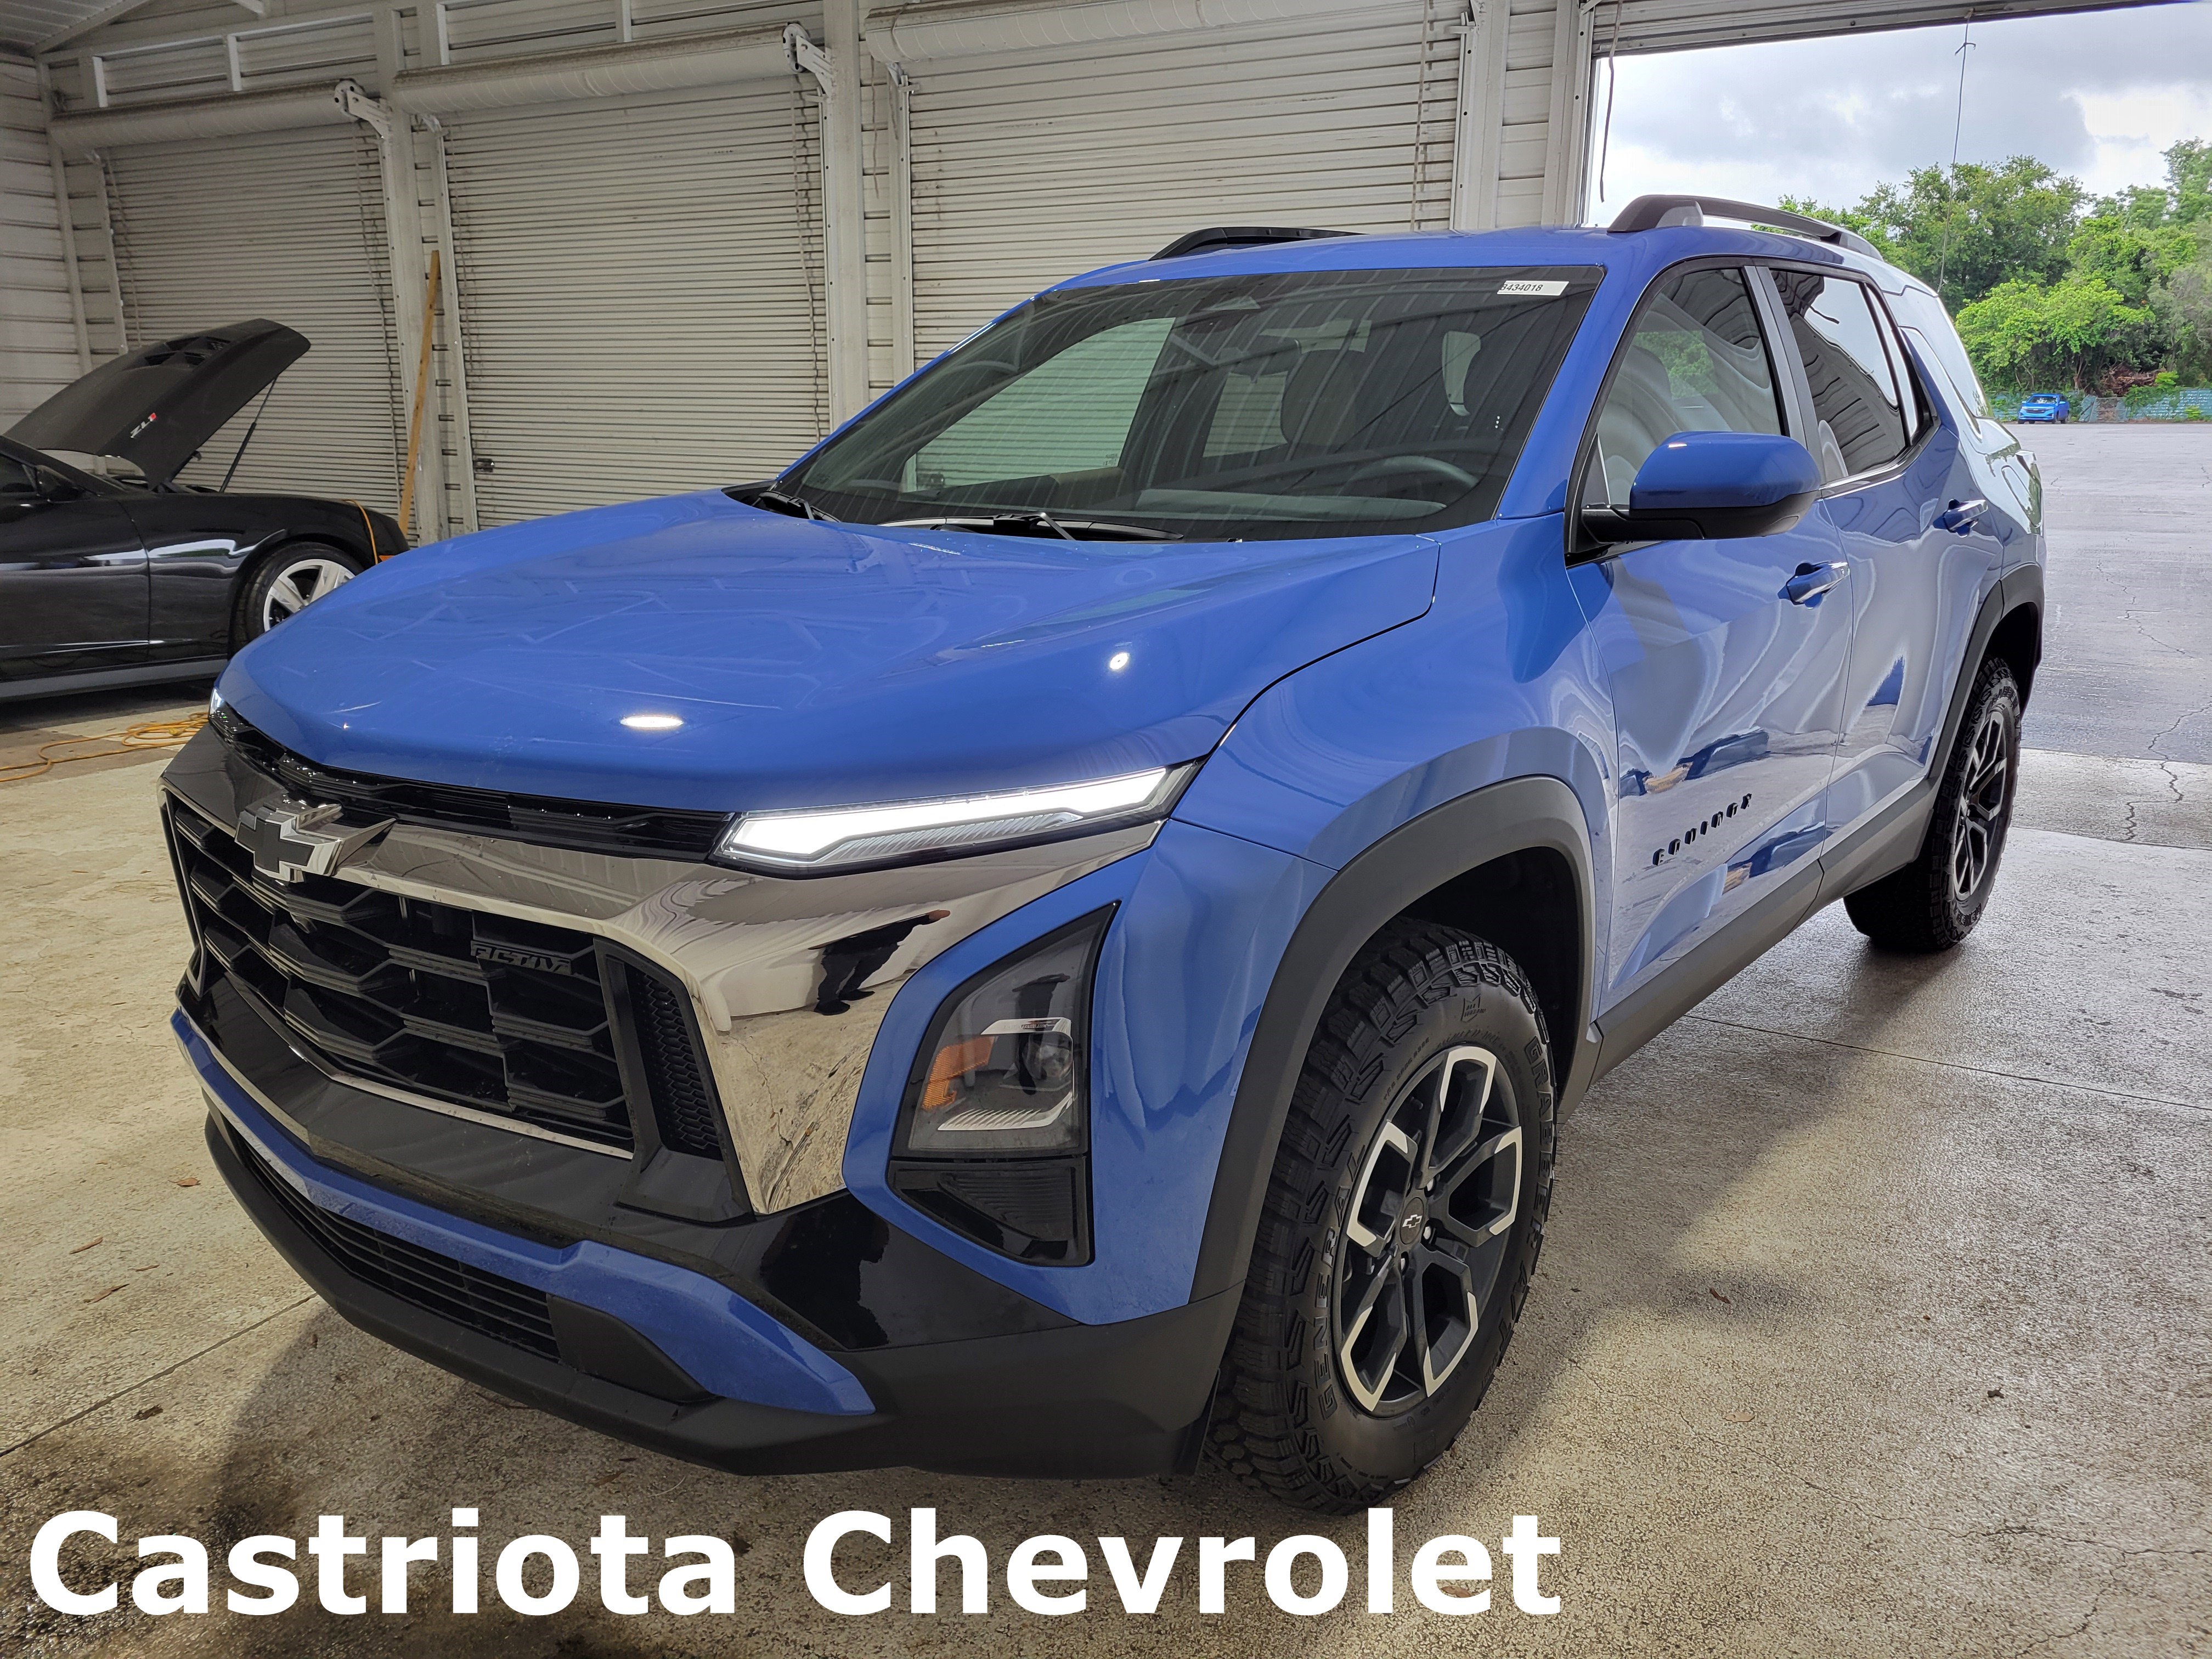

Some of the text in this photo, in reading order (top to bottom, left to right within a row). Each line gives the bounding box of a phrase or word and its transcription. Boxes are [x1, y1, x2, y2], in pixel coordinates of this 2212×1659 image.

[471, 943, 572, 975] ACTIV
[1523, 1036, 1553, 1250] GRABBER
[1313, 1145, 1365, 1420] GENERAL
